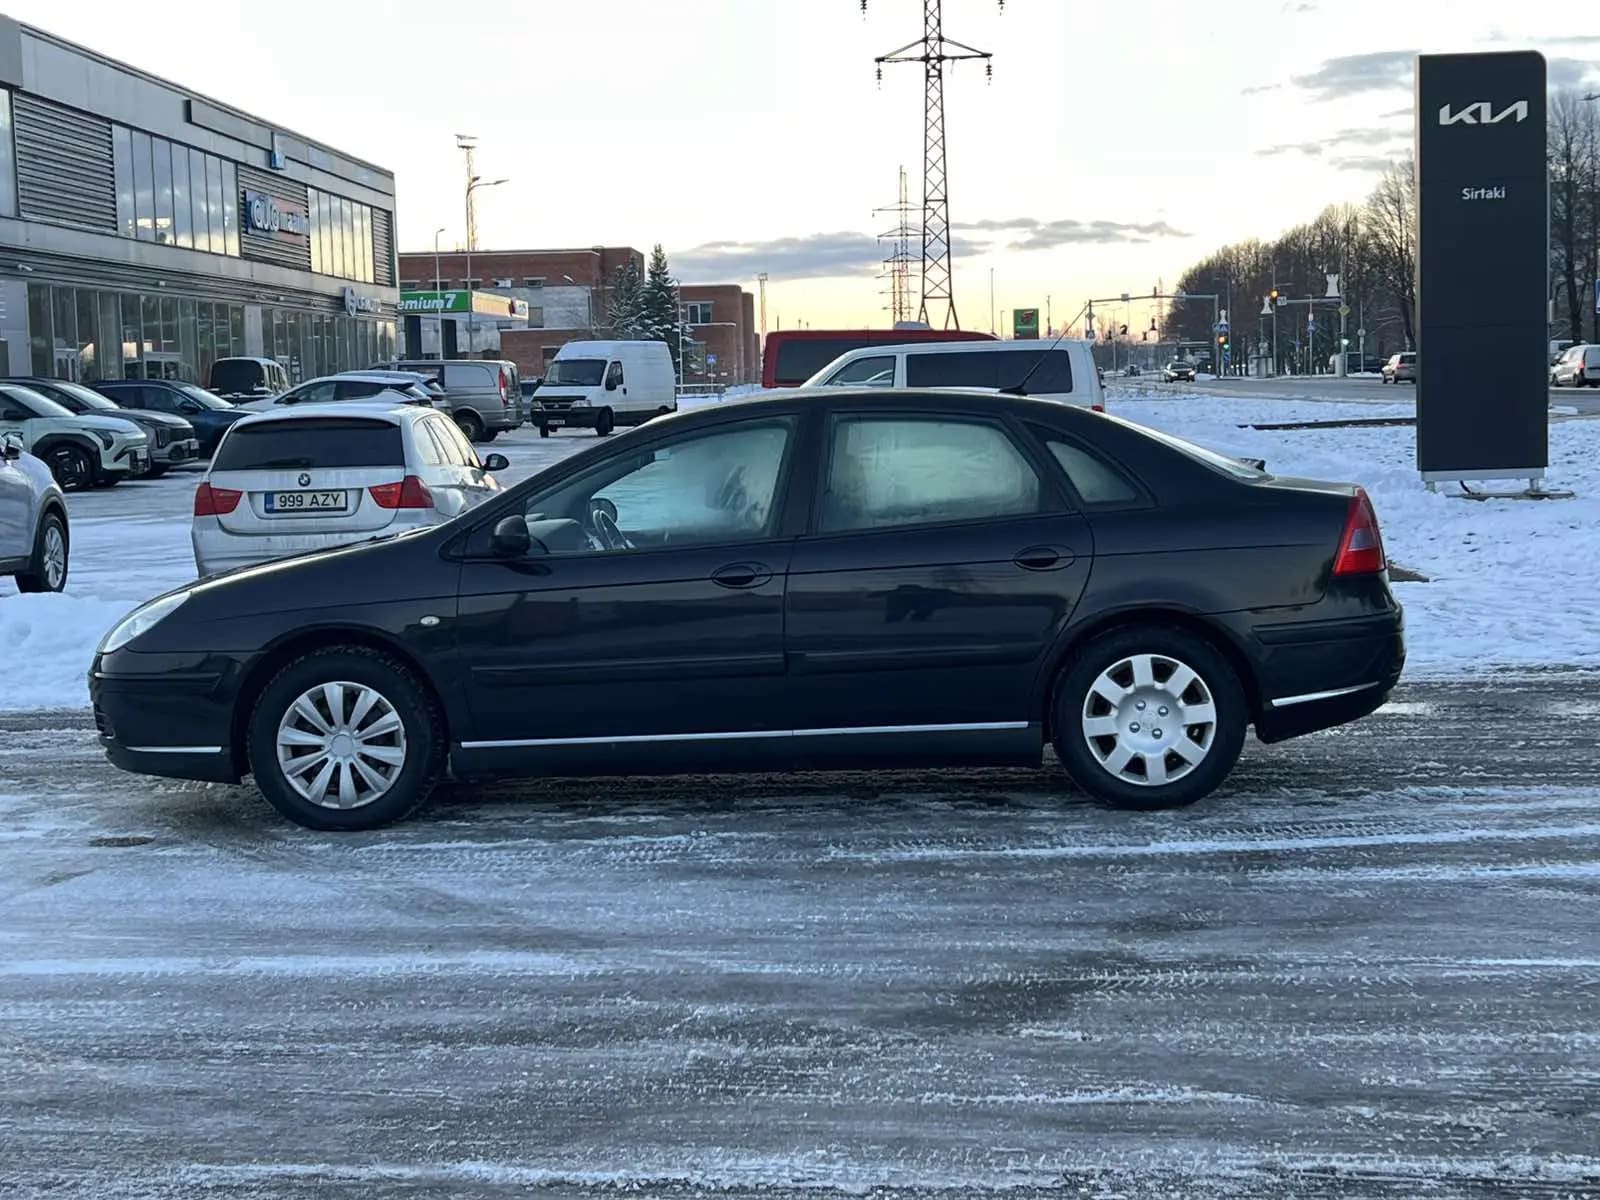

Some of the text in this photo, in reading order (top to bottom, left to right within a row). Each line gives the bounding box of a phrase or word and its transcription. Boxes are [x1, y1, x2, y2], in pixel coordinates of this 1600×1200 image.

[1440, 101, 1528, 125] KIA
[1462, 187, 1505, 200] Sirtaki
[279, 494, 304, 508] 999
[309, 493, 341, 507] AZY
